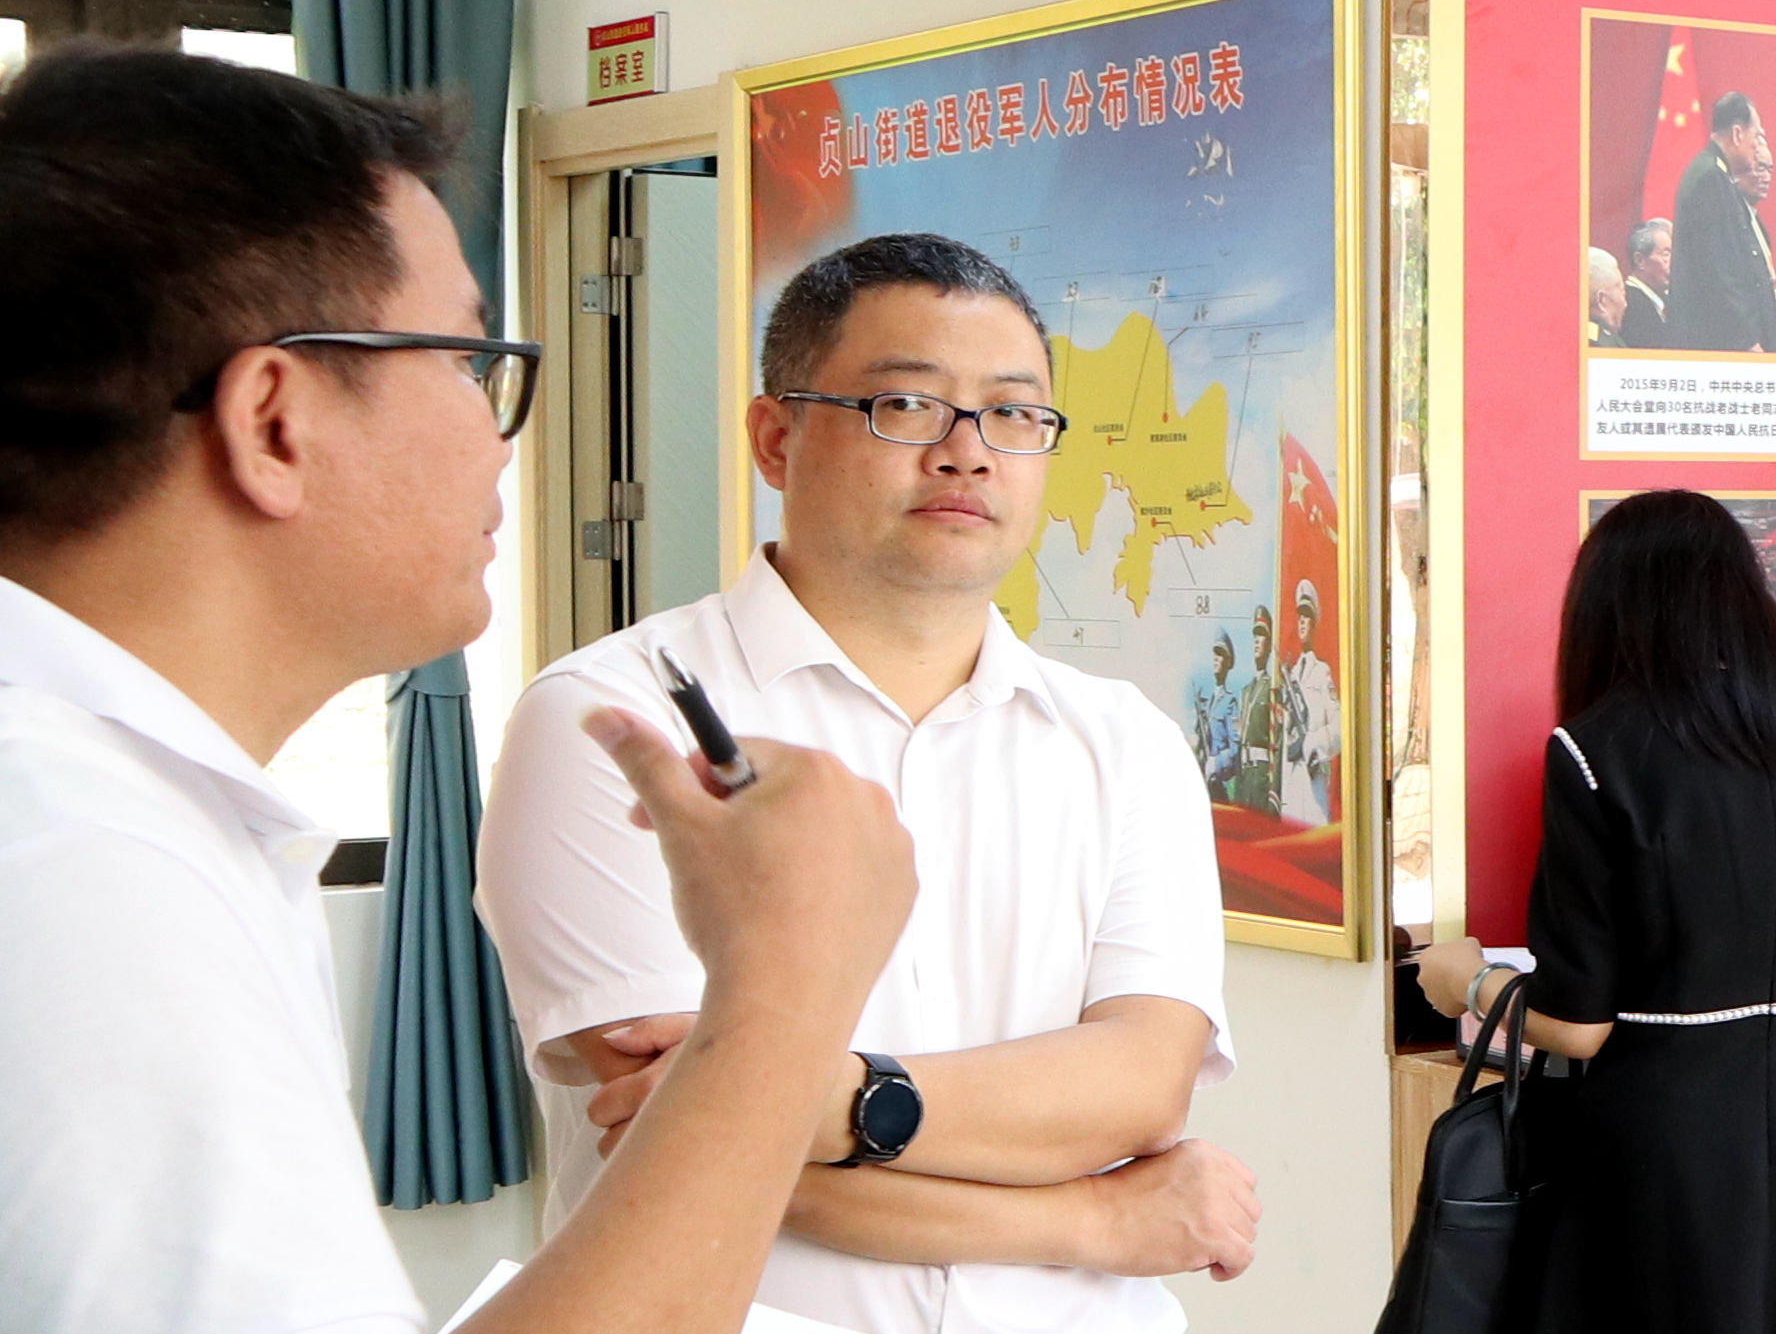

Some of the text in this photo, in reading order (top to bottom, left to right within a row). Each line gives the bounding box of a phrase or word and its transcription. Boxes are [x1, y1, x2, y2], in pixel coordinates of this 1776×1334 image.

[599, 50, 645, 89] 档案室
[818, 42, 1244, 178] 贞山街道退役军人分布情况表
